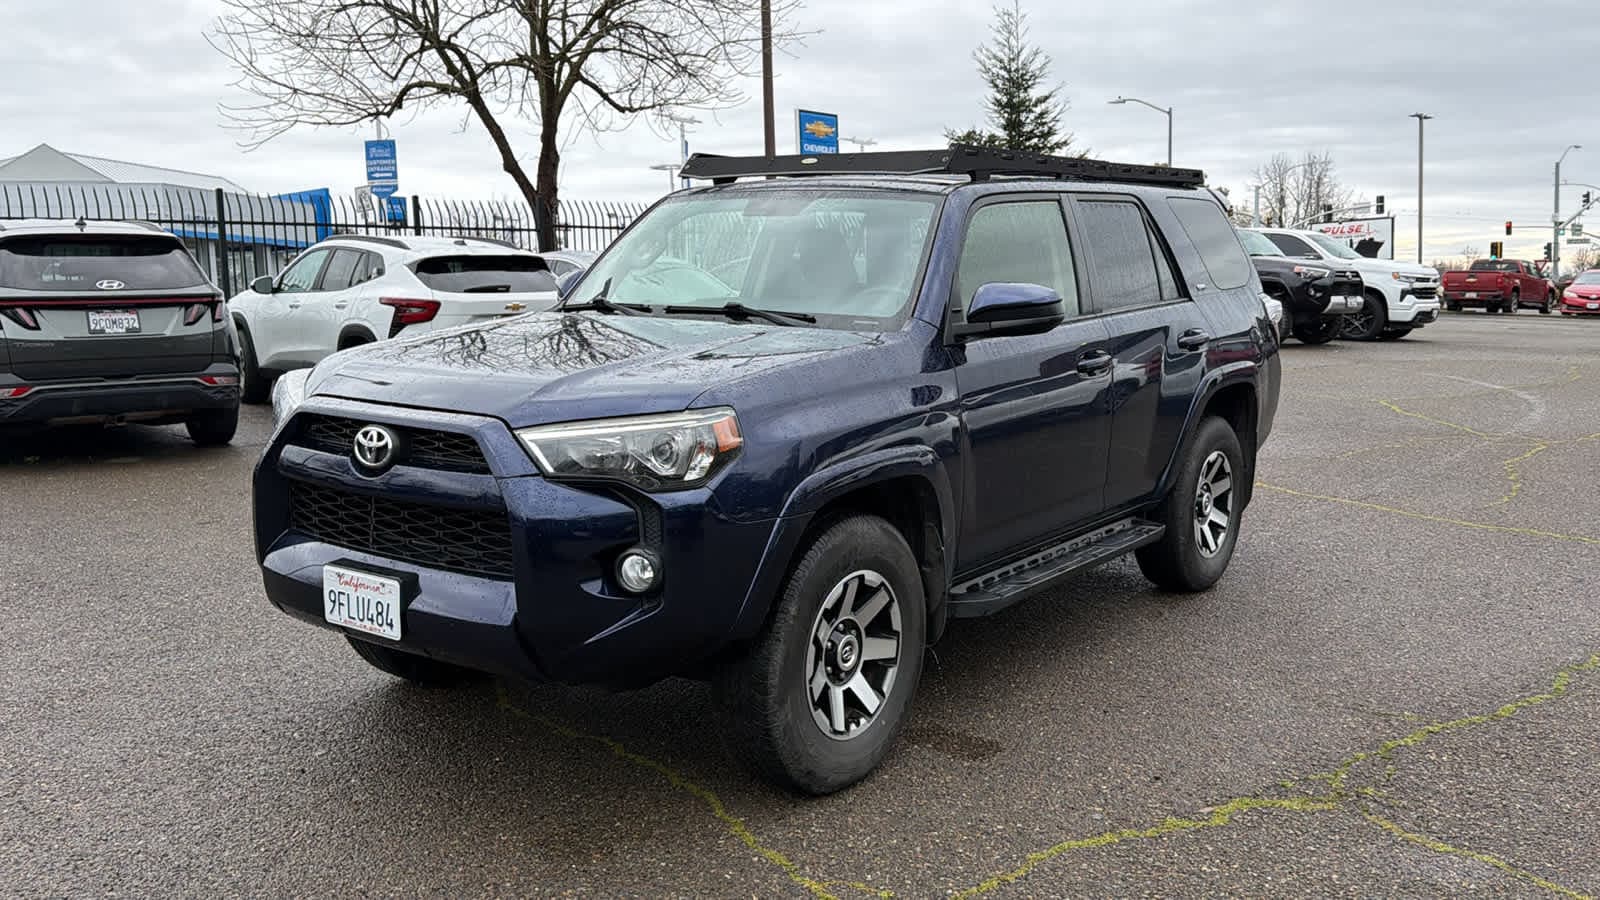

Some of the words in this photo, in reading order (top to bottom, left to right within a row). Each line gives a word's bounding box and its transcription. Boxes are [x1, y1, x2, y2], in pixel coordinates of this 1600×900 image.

[803, 143, 837, 154] CHEVROLET
[336, 573, 387, 593] California
[328, 589, 394, 631] 9FLU484
